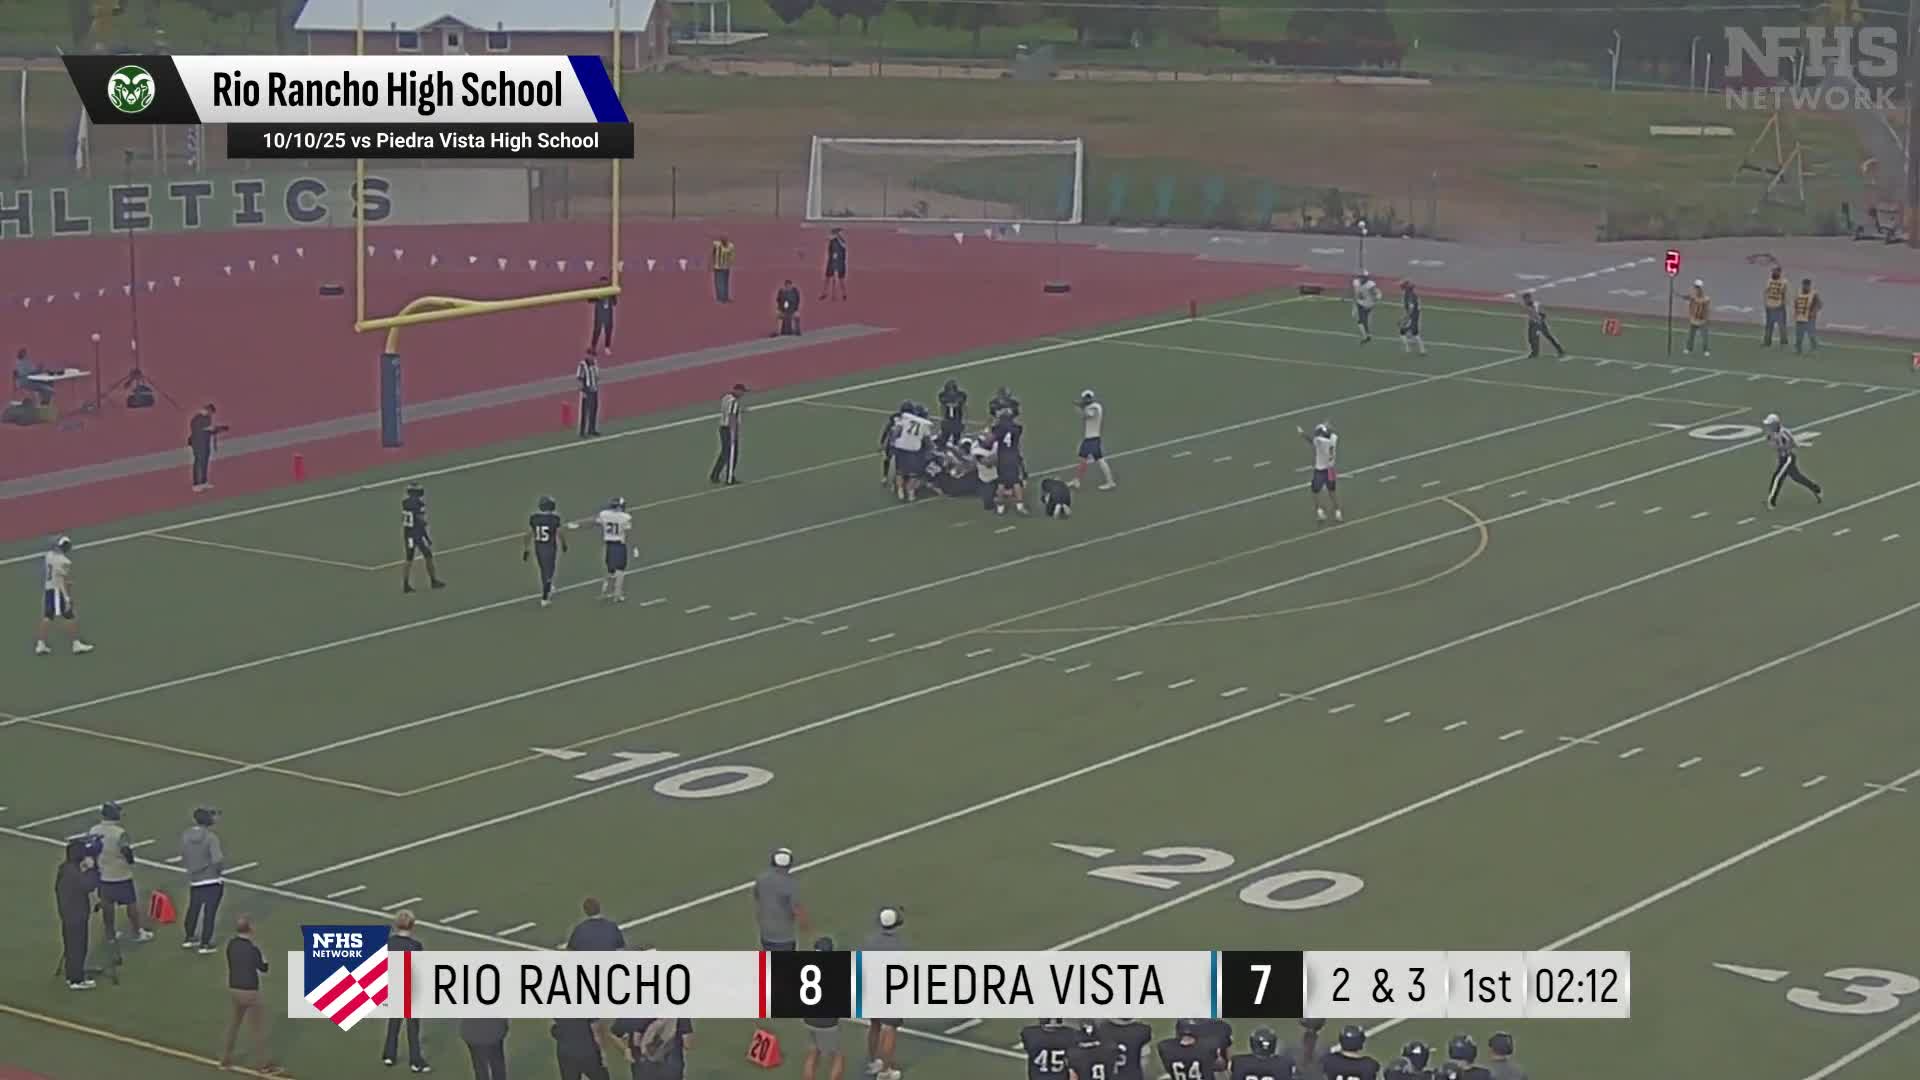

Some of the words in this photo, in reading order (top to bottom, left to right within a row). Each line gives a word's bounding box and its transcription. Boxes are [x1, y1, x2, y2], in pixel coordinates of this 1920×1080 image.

[1666, 251, 1679, 274] 2
[906, 420, 921, 436] 71
[1003, 431, 1012, 448] 4
[535, 525, 550, 542] 15
[574, 751, 774, 798] 10
[1086, 846, 1364, 910] 20
[751, 1032, 770, 1061] 20
[1034, 1049, 1065, 1072] 45
[1172, 1061, 1201, 1080] 64
